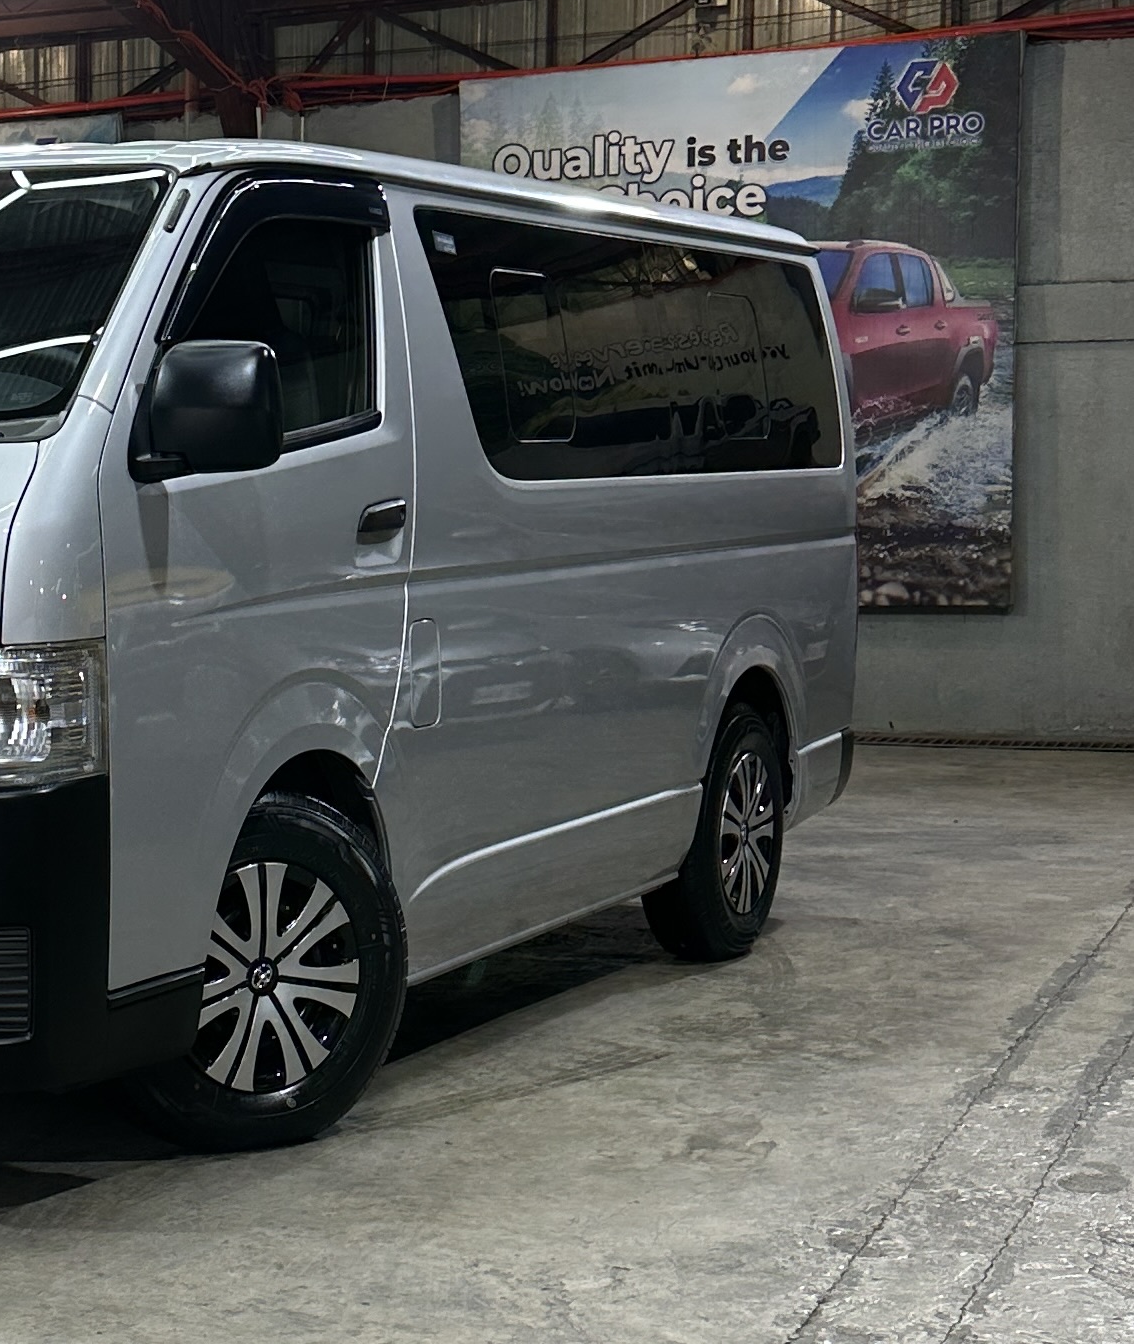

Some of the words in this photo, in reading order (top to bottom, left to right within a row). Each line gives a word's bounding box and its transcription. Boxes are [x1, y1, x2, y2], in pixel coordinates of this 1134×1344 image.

[867, 116, 922, 142] CAR
[928, 111, 985, 137] PRO
[492, 130, 675, 183] Quality
[687, 136, 716, 167] is
[727, 135, 790, 164] the
[597, 174, 767, 217] hoice
